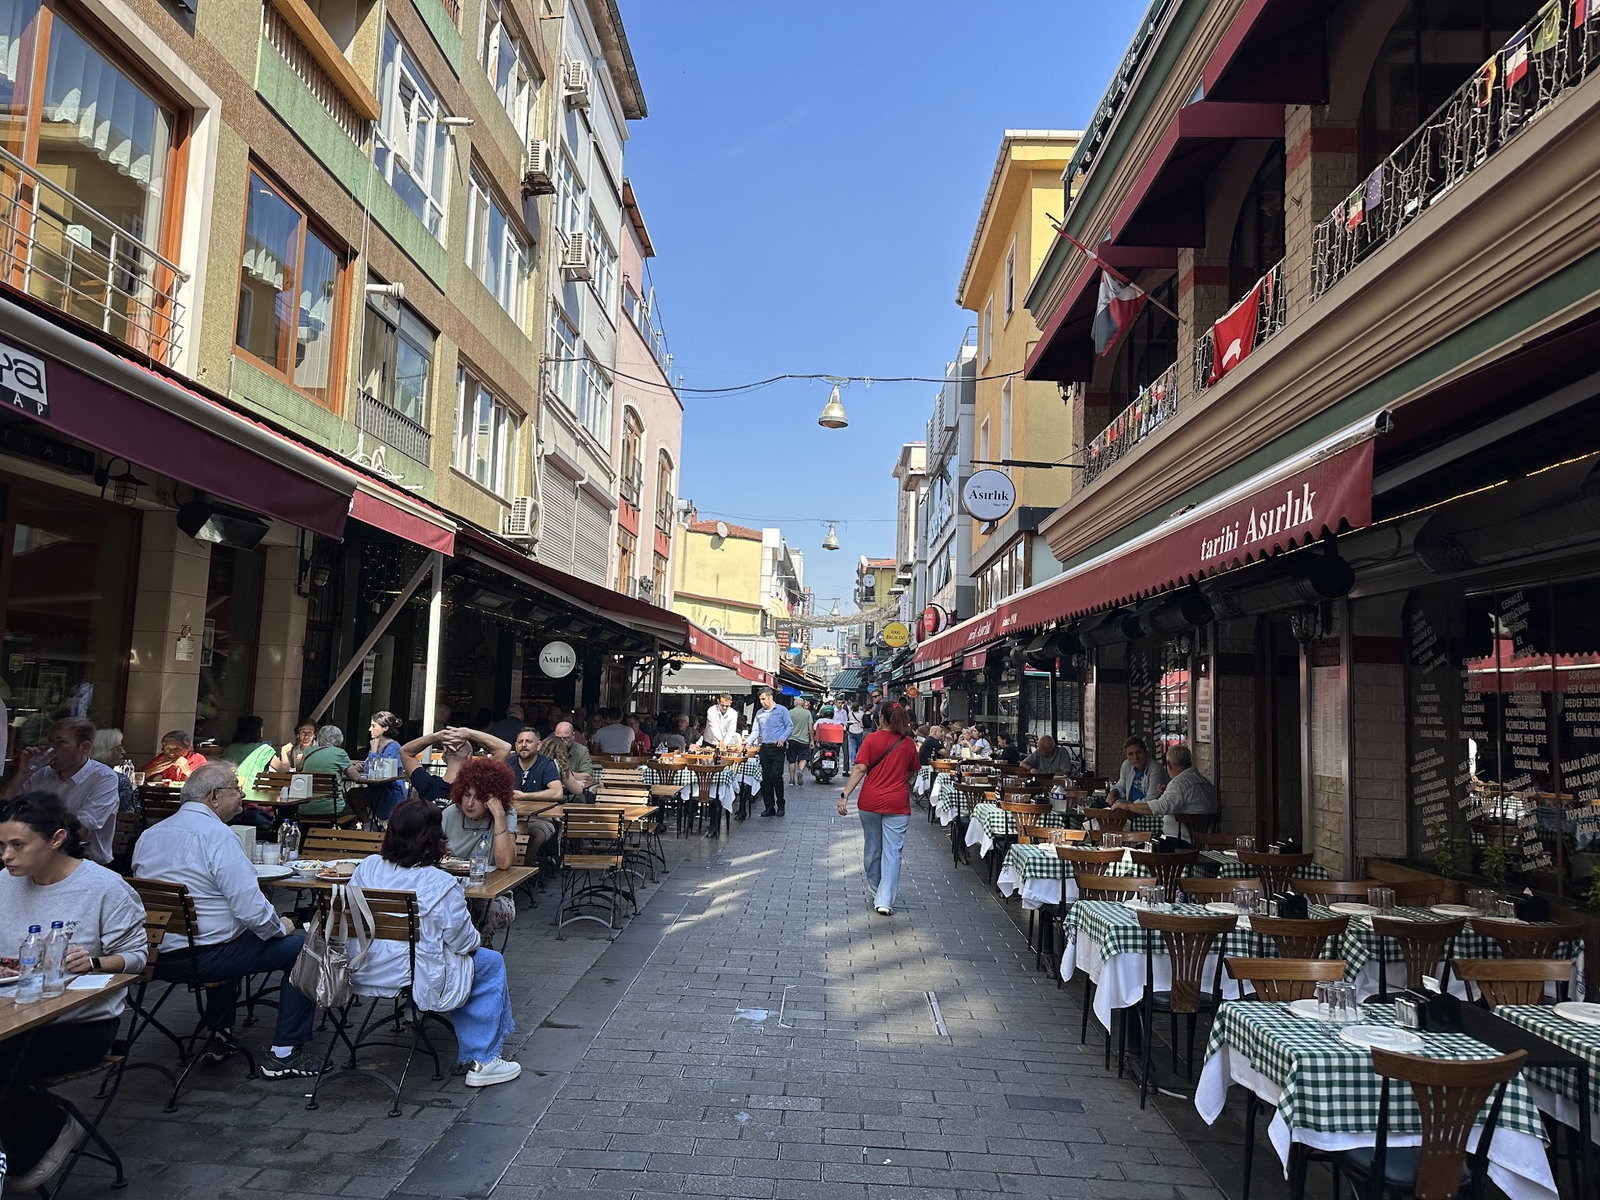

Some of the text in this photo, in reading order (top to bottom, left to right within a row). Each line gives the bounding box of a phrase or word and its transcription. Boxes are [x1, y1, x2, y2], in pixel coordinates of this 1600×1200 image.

[969, 489, 1009, 501] Asırlık
[1200, 482, 1316, 561] tarihi Asırlık
[1501, 591, 1524, 609] CEHALET
[543, 655, 571, 663] Asırlık
[1567, 684, 1578, 694] HER
[1564, 698, 1583, 708] HEDEF
[1565, 711, 1577, 722] SEN
[1524, 733, 1534, 743] HER
[1560, 758, 1581, 774] YALAN
[1564, 774, 1583, 789] PARA
[1578, 784, 1599, 802] SENİN
